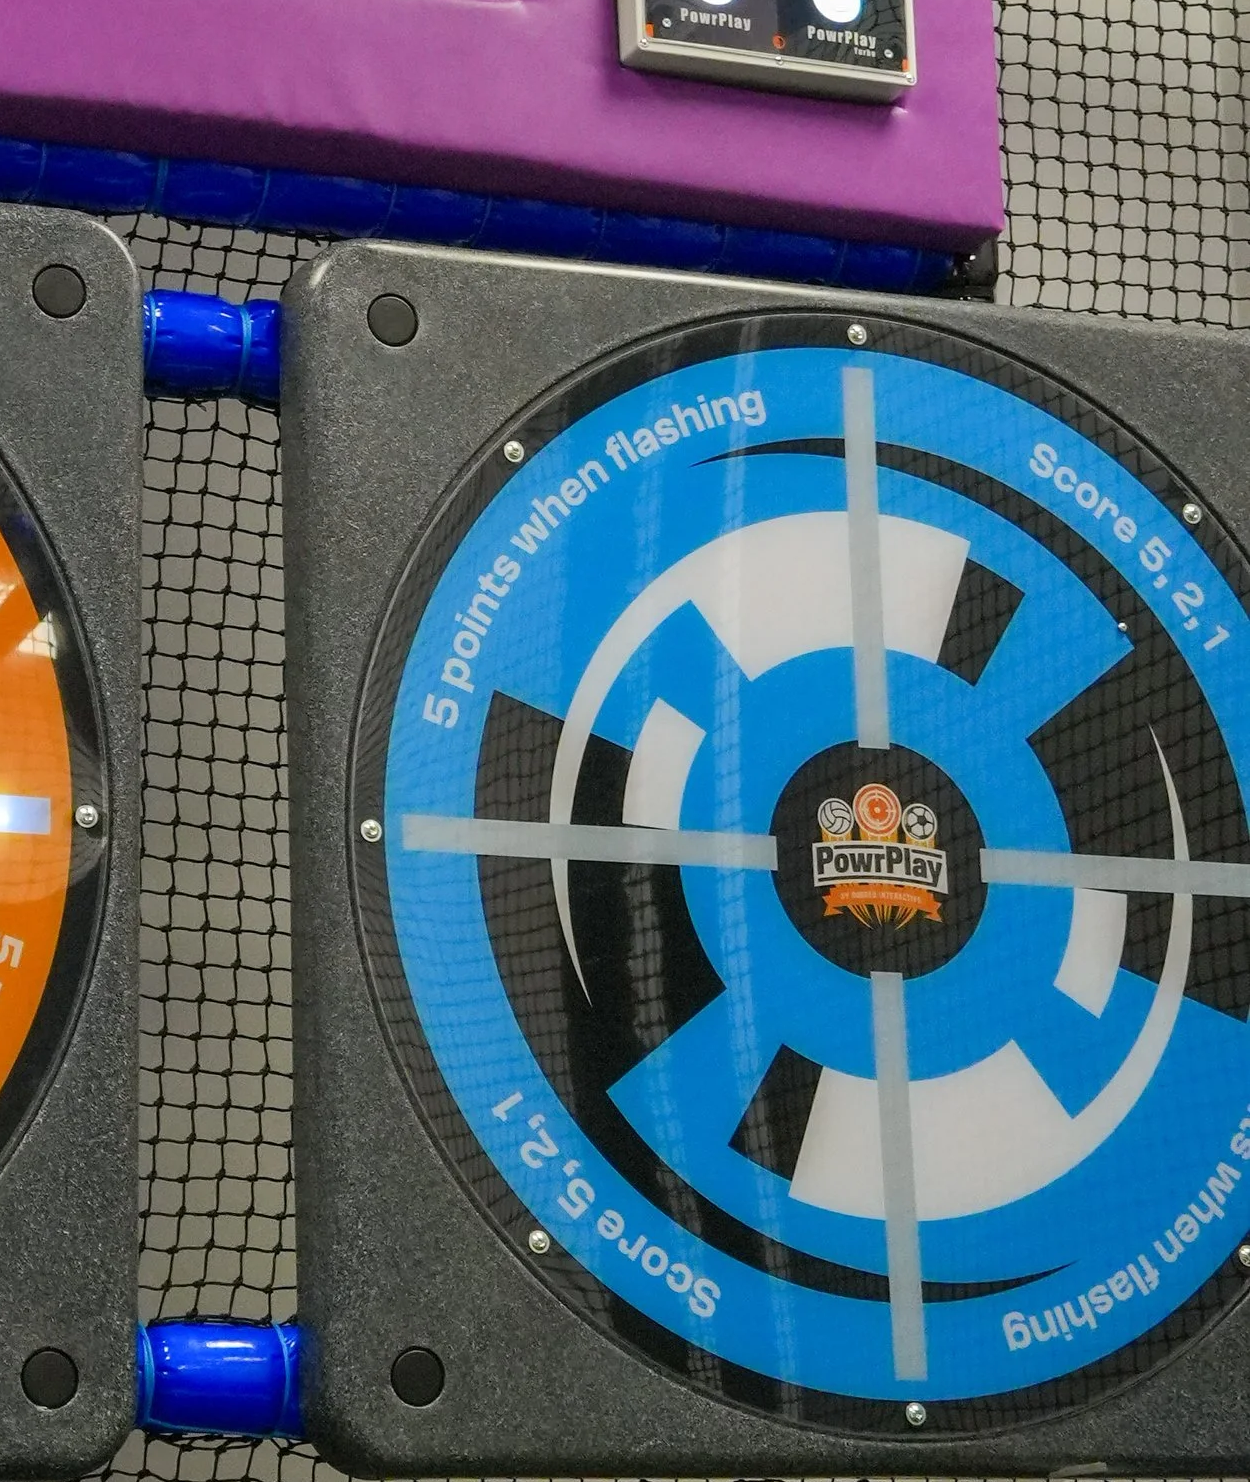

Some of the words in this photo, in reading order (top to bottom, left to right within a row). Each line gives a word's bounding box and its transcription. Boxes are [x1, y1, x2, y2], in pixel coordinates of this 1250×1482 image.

[680, 7, 751, 32] PowrPlay
[807, 25, 877, 49] PowrPlay
[605, 389, 767, 471] flashing
[510, 459, 610, 557] when
[1029, 443, 1138, 543] Score
[1138, 535, 1173, 590] 5,
[1171, 581, 1206, 631] 2,
[1203, 624, 1231, 652] 1
[440, 553, 522, 694] points
[422, 693, 460, 729] 5
[816, 845, 943, 887] PowrPlay
[491, 1090, 524, 1122] 1
[520, 1113, 560, 1169] 2,
[556, 1159, 596, 1220] 5,
[1153, 1161, 1242, 1263] when
[596, 1209, 722, 1318] Score
[1002, 1254, 1160, 1352] flashing
